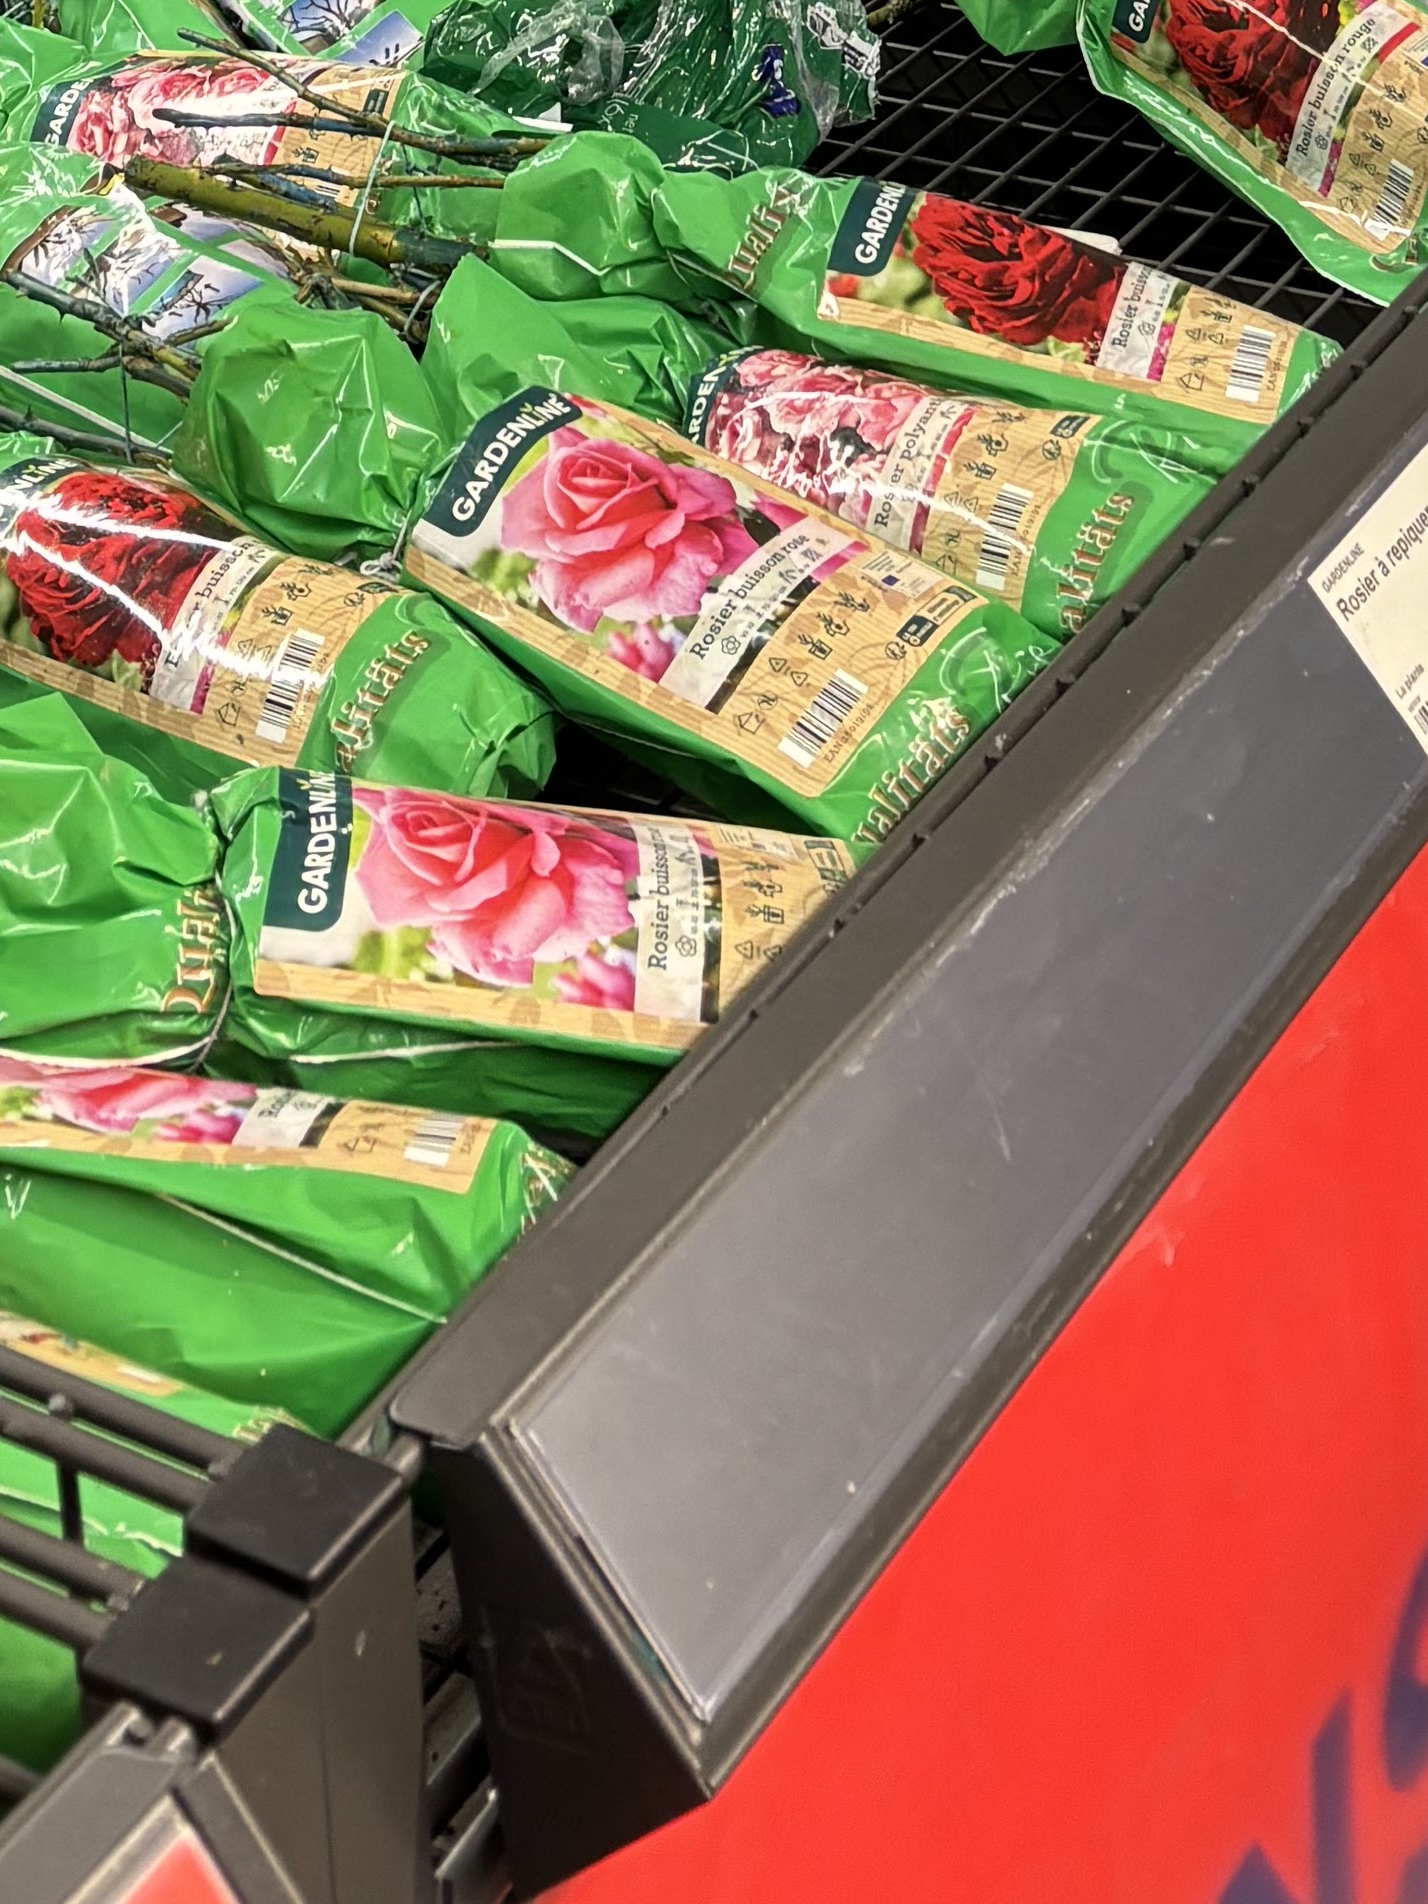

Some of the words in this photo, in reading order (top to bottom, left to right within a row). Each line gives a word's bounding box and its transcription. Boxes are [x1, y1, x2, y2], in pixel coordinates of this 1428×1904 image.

[1295, 108, 1318, 158] Rosier
[1342, 17, 1377, 56] rouge
[450, 391, 570, 525] GARDENLINE
[874, 463, 902, 529] Roser
[1322, 542, 1365, 595] GARDENLINE
[1335, 574, 1381, 623] Rosier
[1377, 556, 1390, 580] à
[688, 601, 738, 662] Rosier
[733, 552, 785, 600] buisson
[648, 908, 670, 972] Rosier
